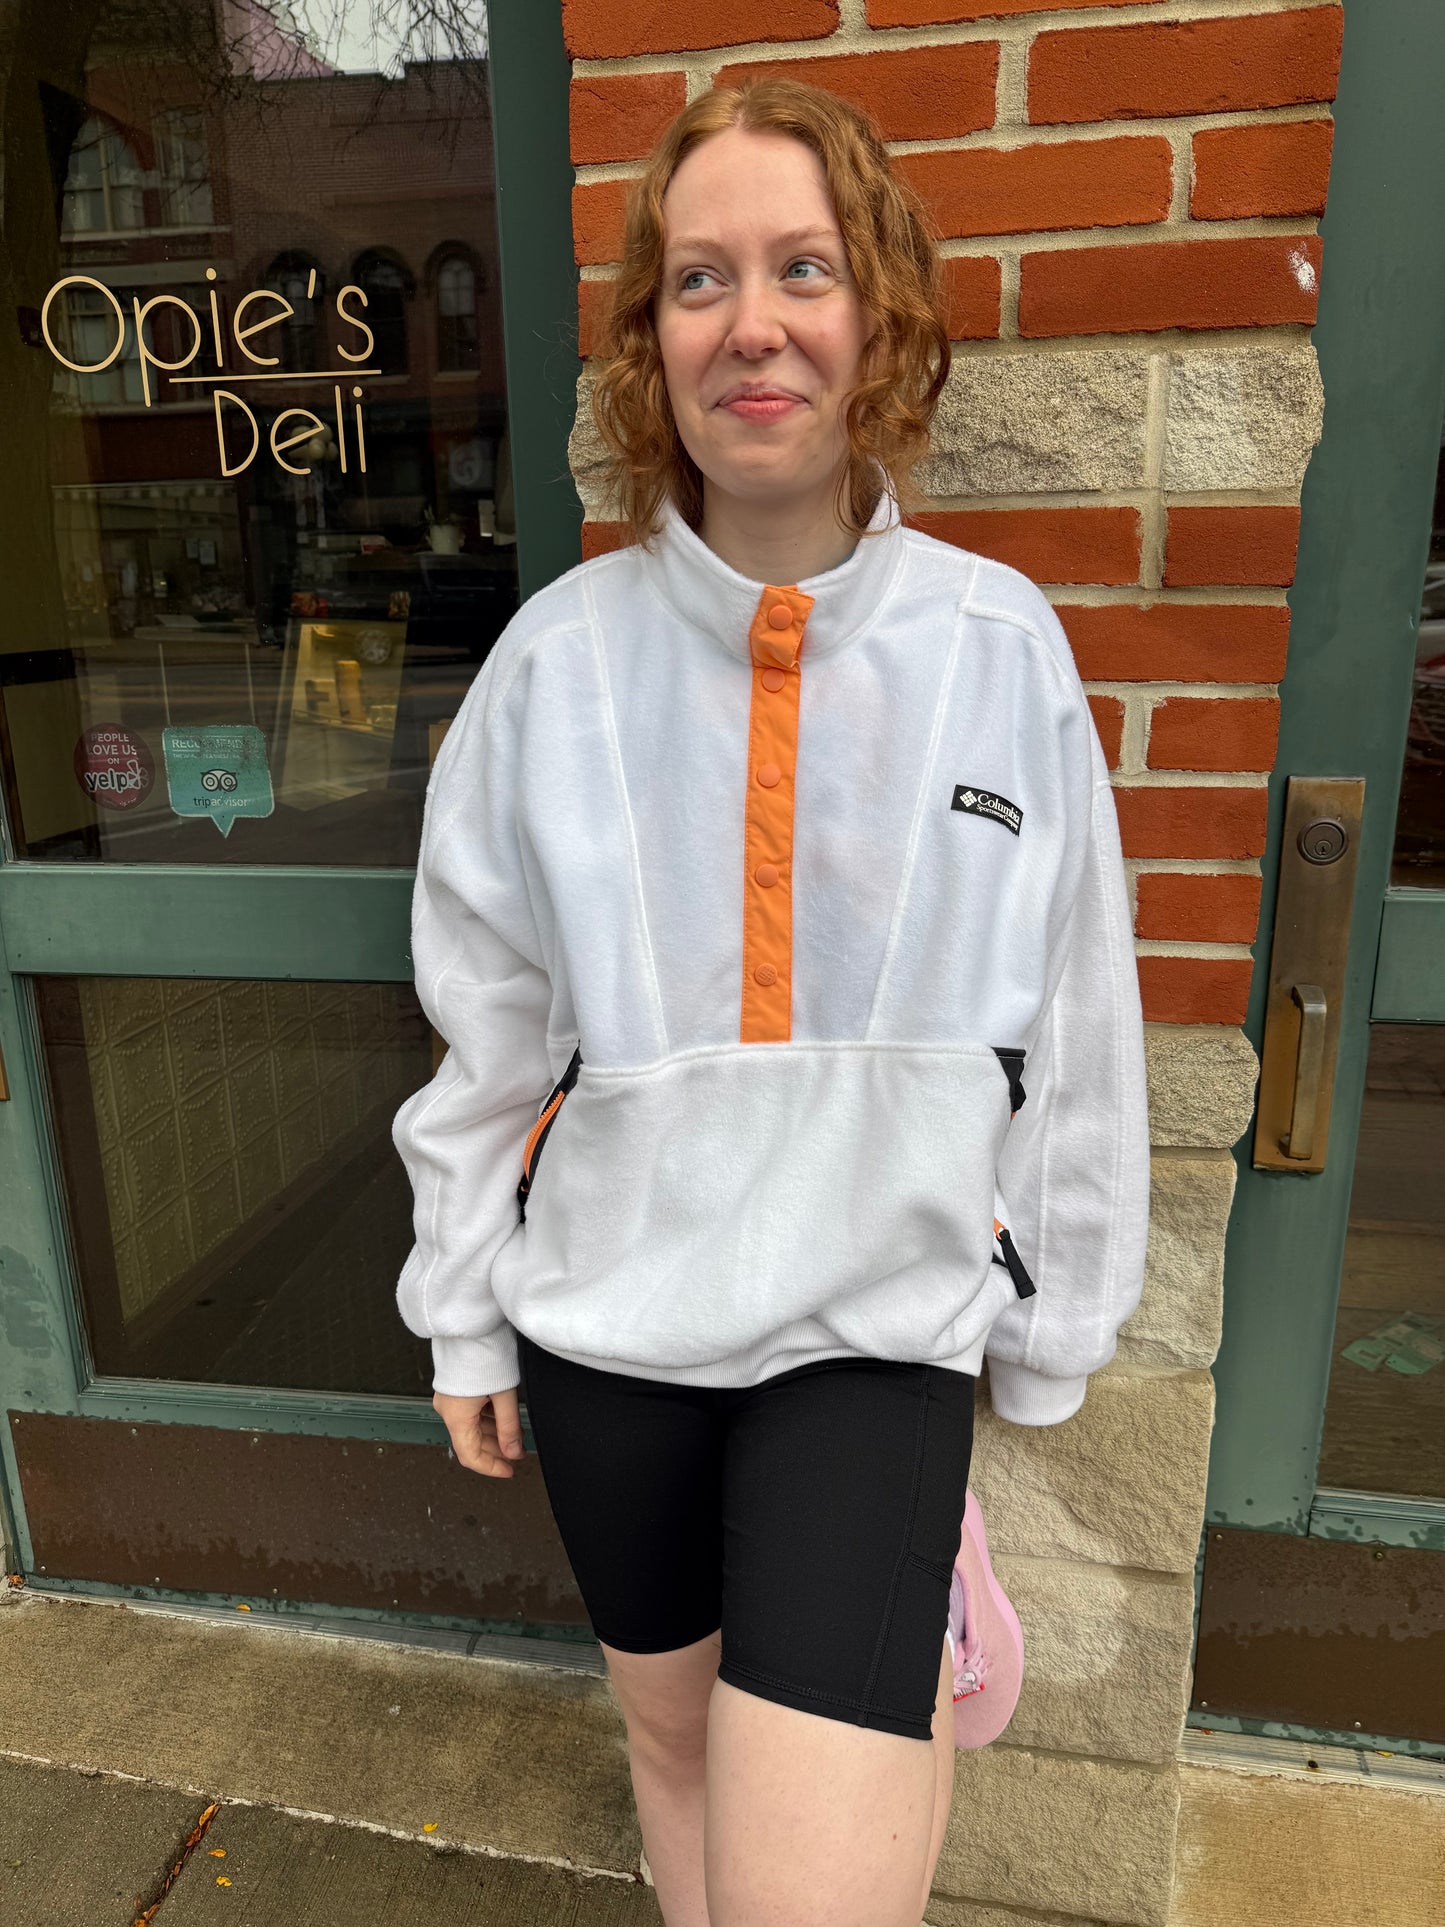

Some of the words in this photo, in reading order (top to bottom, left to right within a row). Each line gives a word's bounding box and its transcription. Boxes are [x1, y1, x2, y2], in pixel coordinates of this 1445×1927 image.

[41, 267, 374, 407] Opie's
[214, 385, 367, 477] Deli
[91, 733, 129, 742] PEOPLE
[122, 744, 137, 755] US
[107, 757, 120, 765] ON
[84, 768, 129, 793] yelp
[977, 793, 1020, 825] Columbia
